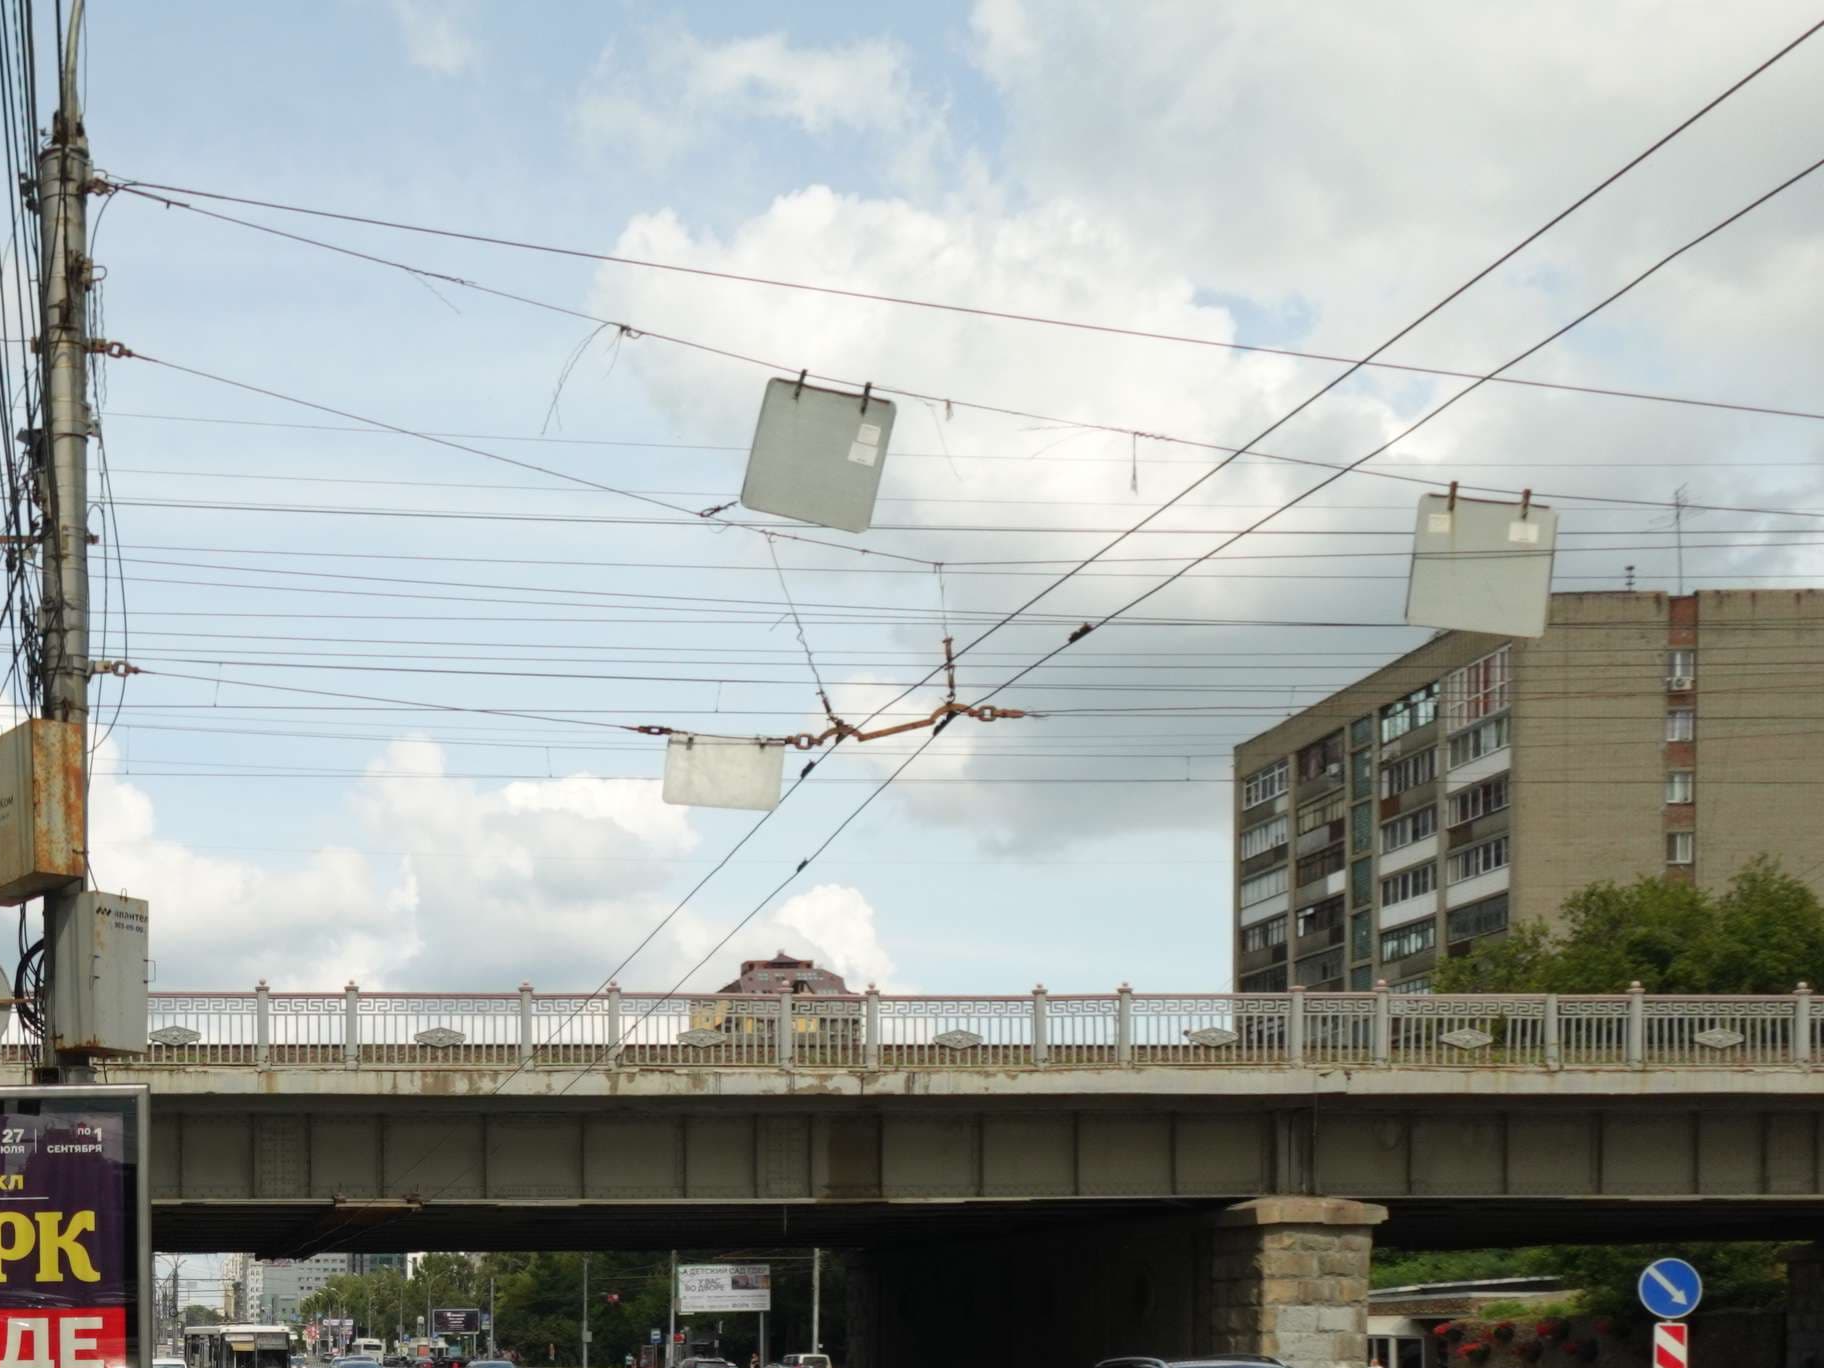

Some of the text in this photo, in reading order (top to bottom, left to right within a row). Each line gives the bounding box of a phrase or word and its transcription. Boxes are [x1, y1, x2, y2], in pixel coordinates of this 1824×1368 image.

[2, 1129, 25, 1143] 27
[94, 1127, 103, 1142] 1
[47, 1144, 103, 1154] СЕНТЯБРЯ
